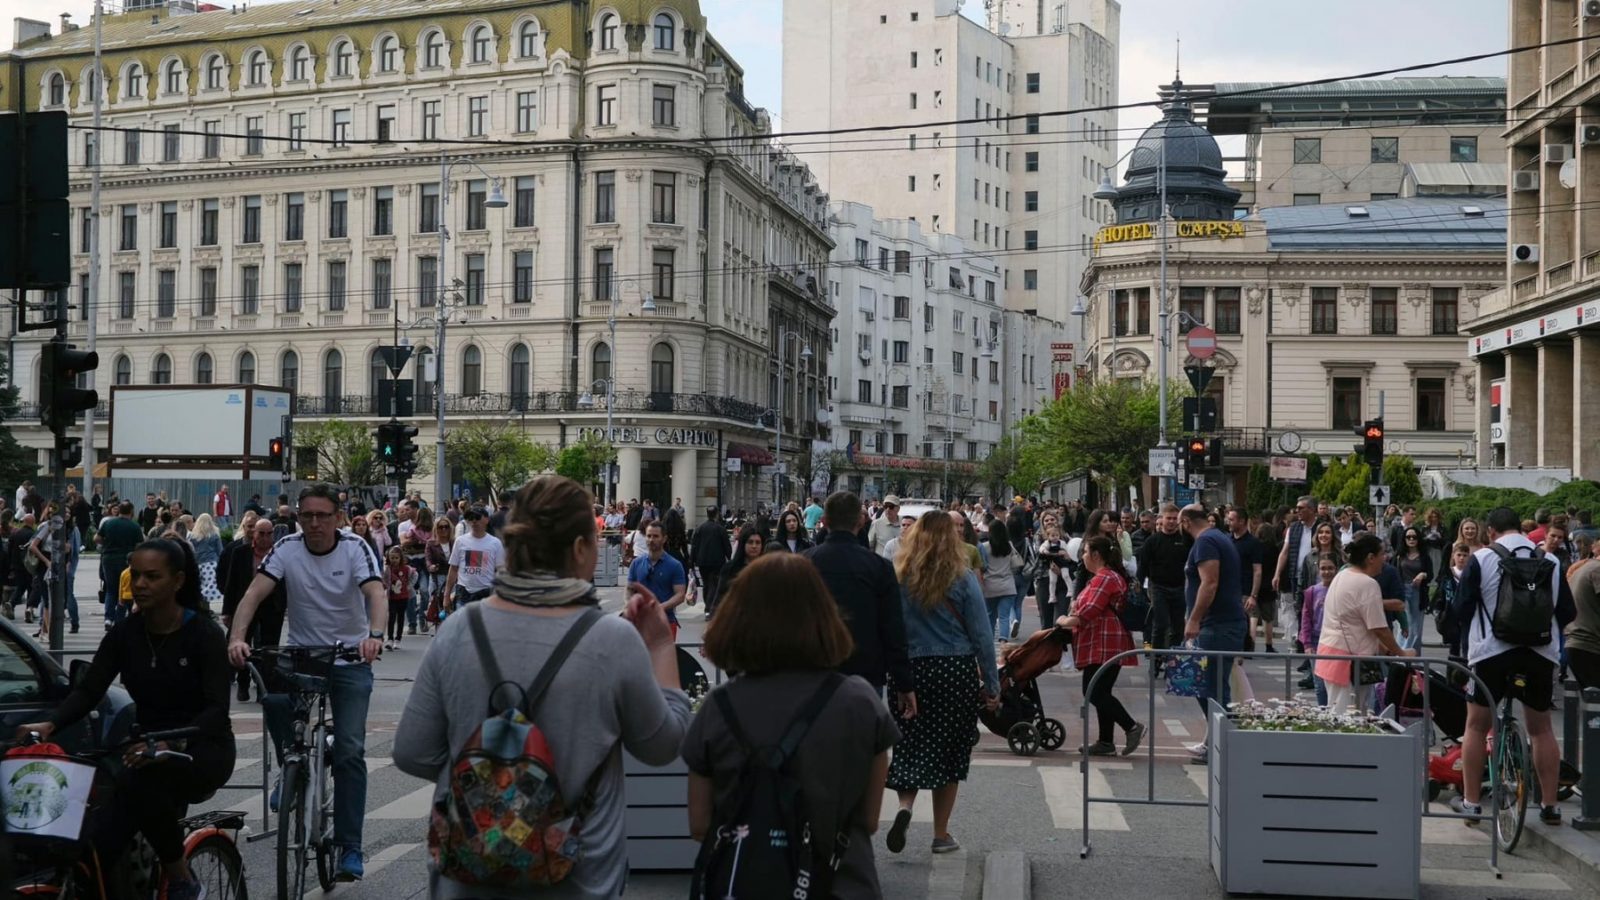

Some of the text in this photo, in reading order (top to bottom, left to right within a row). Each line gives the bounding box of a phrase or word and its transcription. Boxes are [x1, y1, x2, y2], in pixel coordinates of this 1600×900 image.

[1104, 223, 1152, 242] HOTEL
[1585, 307, 1597, 318] BRD
[1547, 319, 1557, 329] BRD
[576, 426, 717, 446] HOTEL CAPITO
